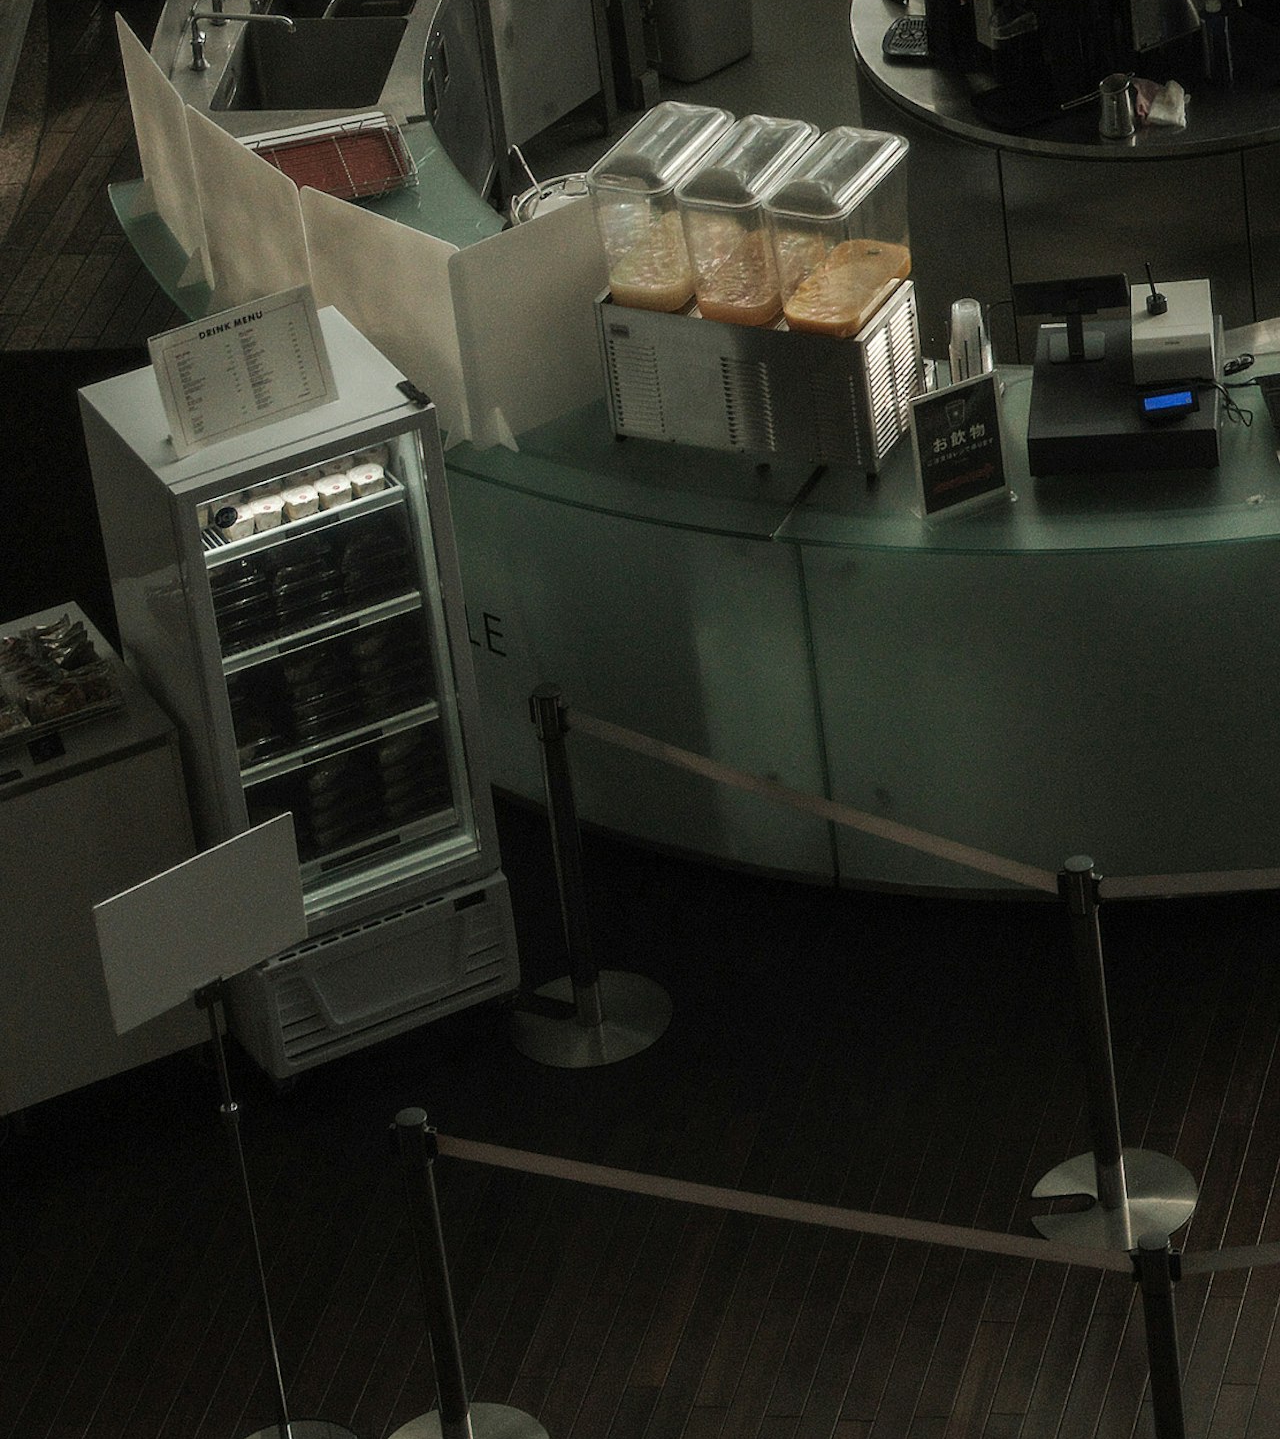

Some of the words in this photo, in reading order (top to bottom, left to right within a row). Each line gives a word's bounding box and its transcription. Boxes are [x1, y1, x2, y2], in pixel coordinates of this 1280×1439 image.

[198, 322, 231, 340] DRINK
[233, 310, 264, 329] MENU
[932, 423, 986, 454] お飲物
